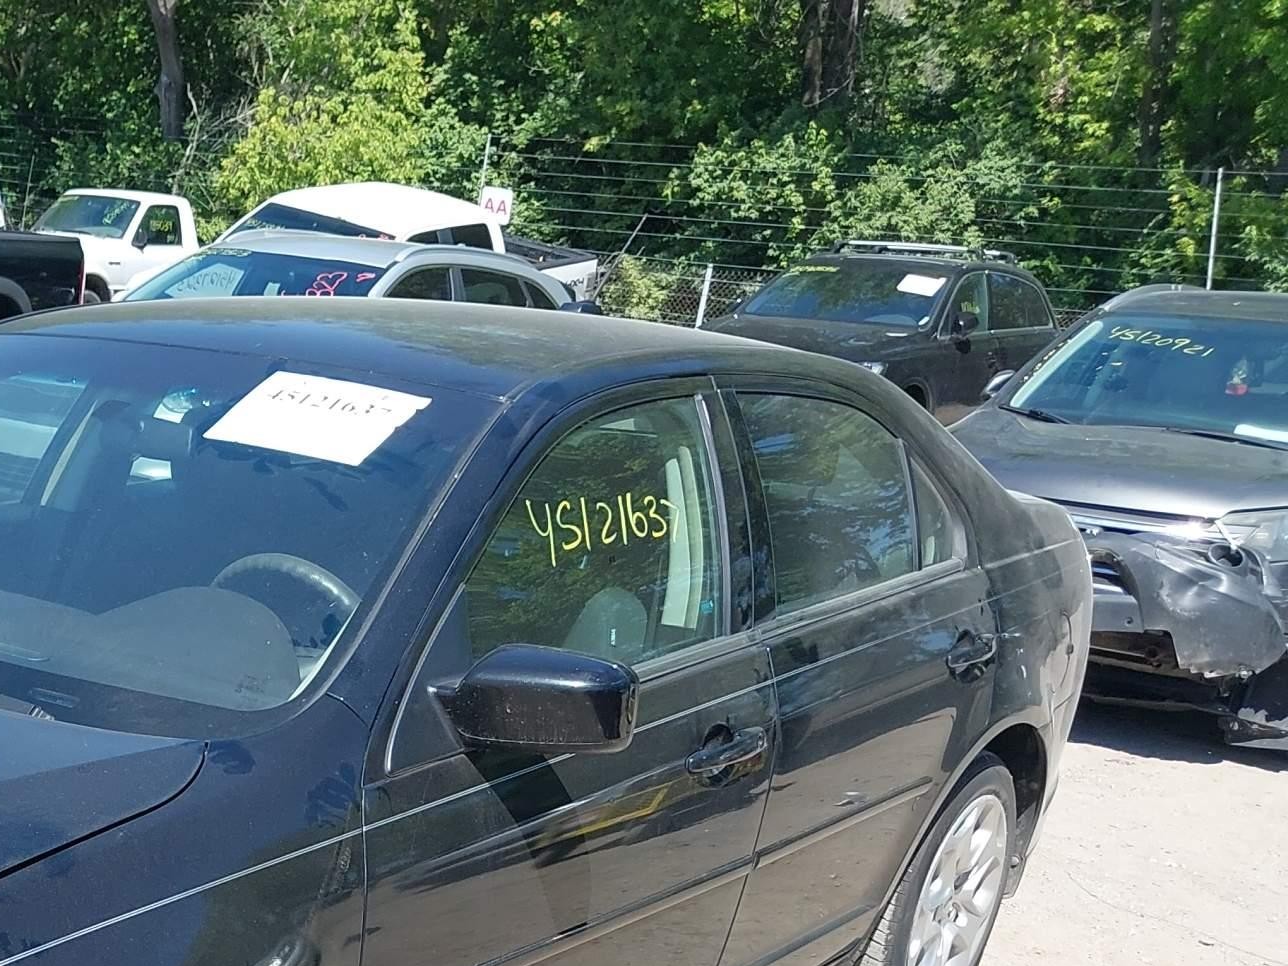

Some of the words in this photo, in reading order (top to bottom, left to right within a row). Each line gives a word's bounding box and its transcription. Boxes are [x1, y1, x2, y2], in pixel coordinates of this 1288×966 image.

[484, 198, 507, 216] AA
[1108, 326, 1215, 357] 45120921
[525, 492, 680, 567] 45121637
